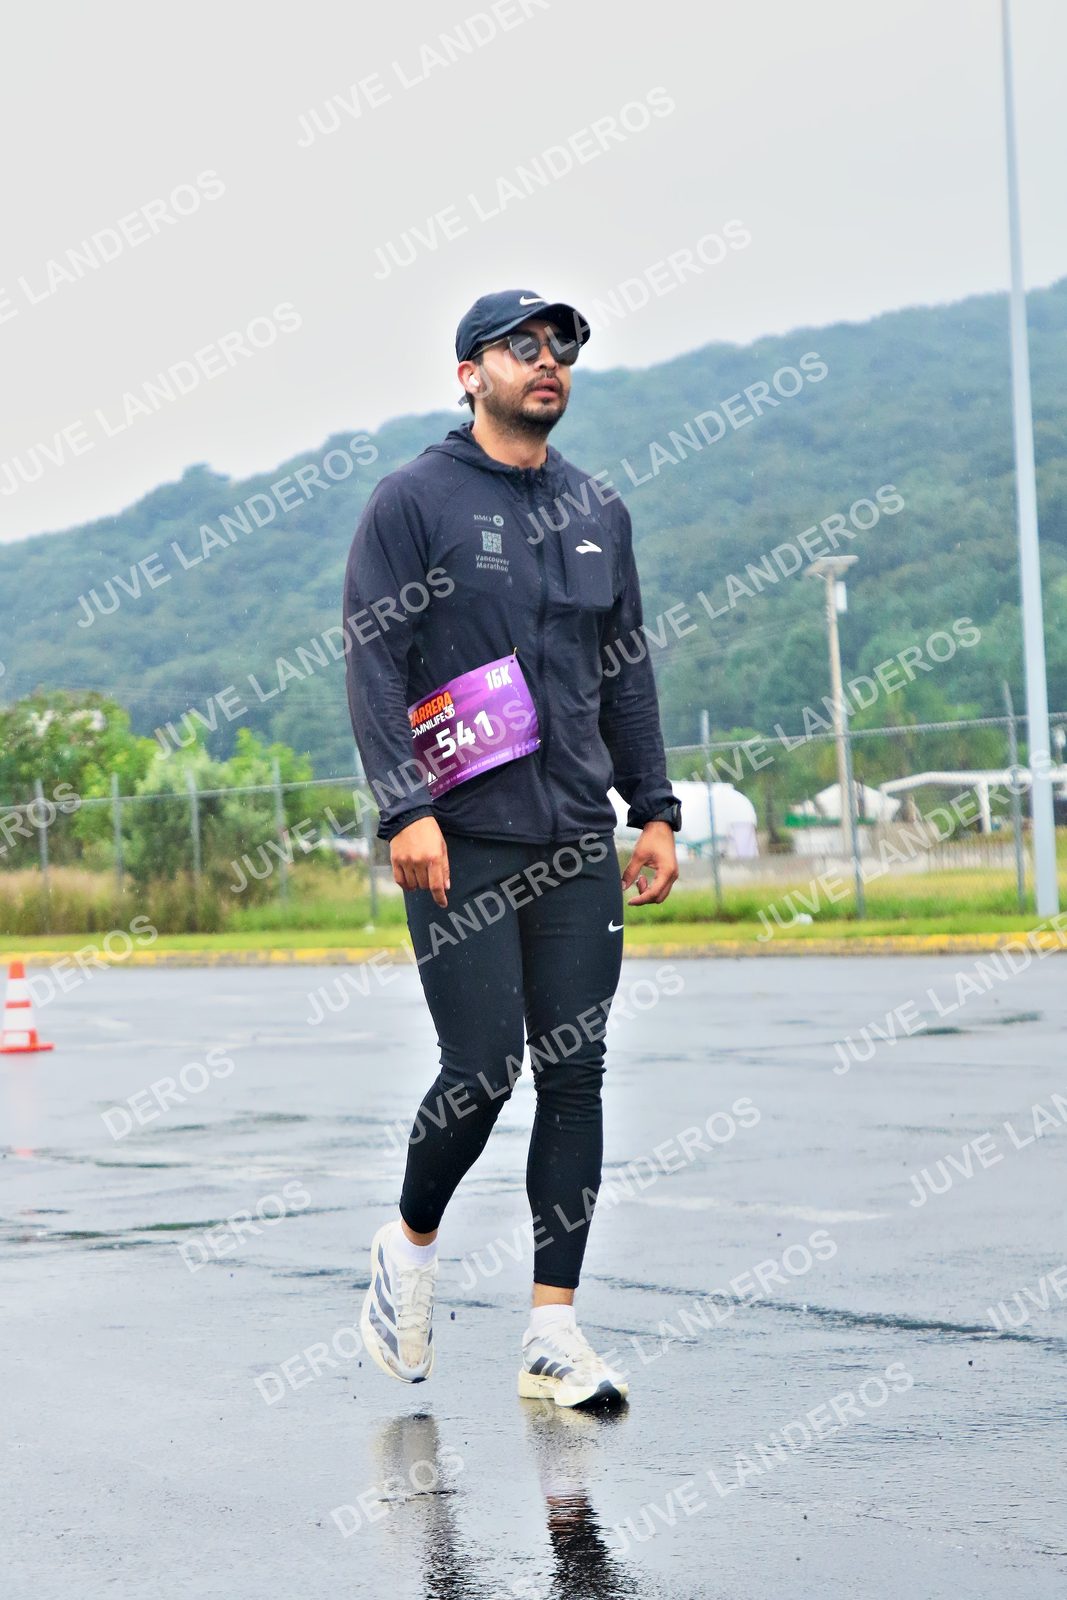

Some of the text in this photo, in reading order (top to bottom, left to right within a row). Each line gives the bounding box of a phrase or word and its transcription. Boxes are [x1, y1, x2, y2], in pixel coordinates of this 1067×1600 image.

[475, 554, 510, 566] Vancouver
[476, 561, 509, 572] Marathon
[485, 664, 512, 691] 16K
[408, 690, 453, 729] ARRERA
[435, 710, 494, 759] 541
